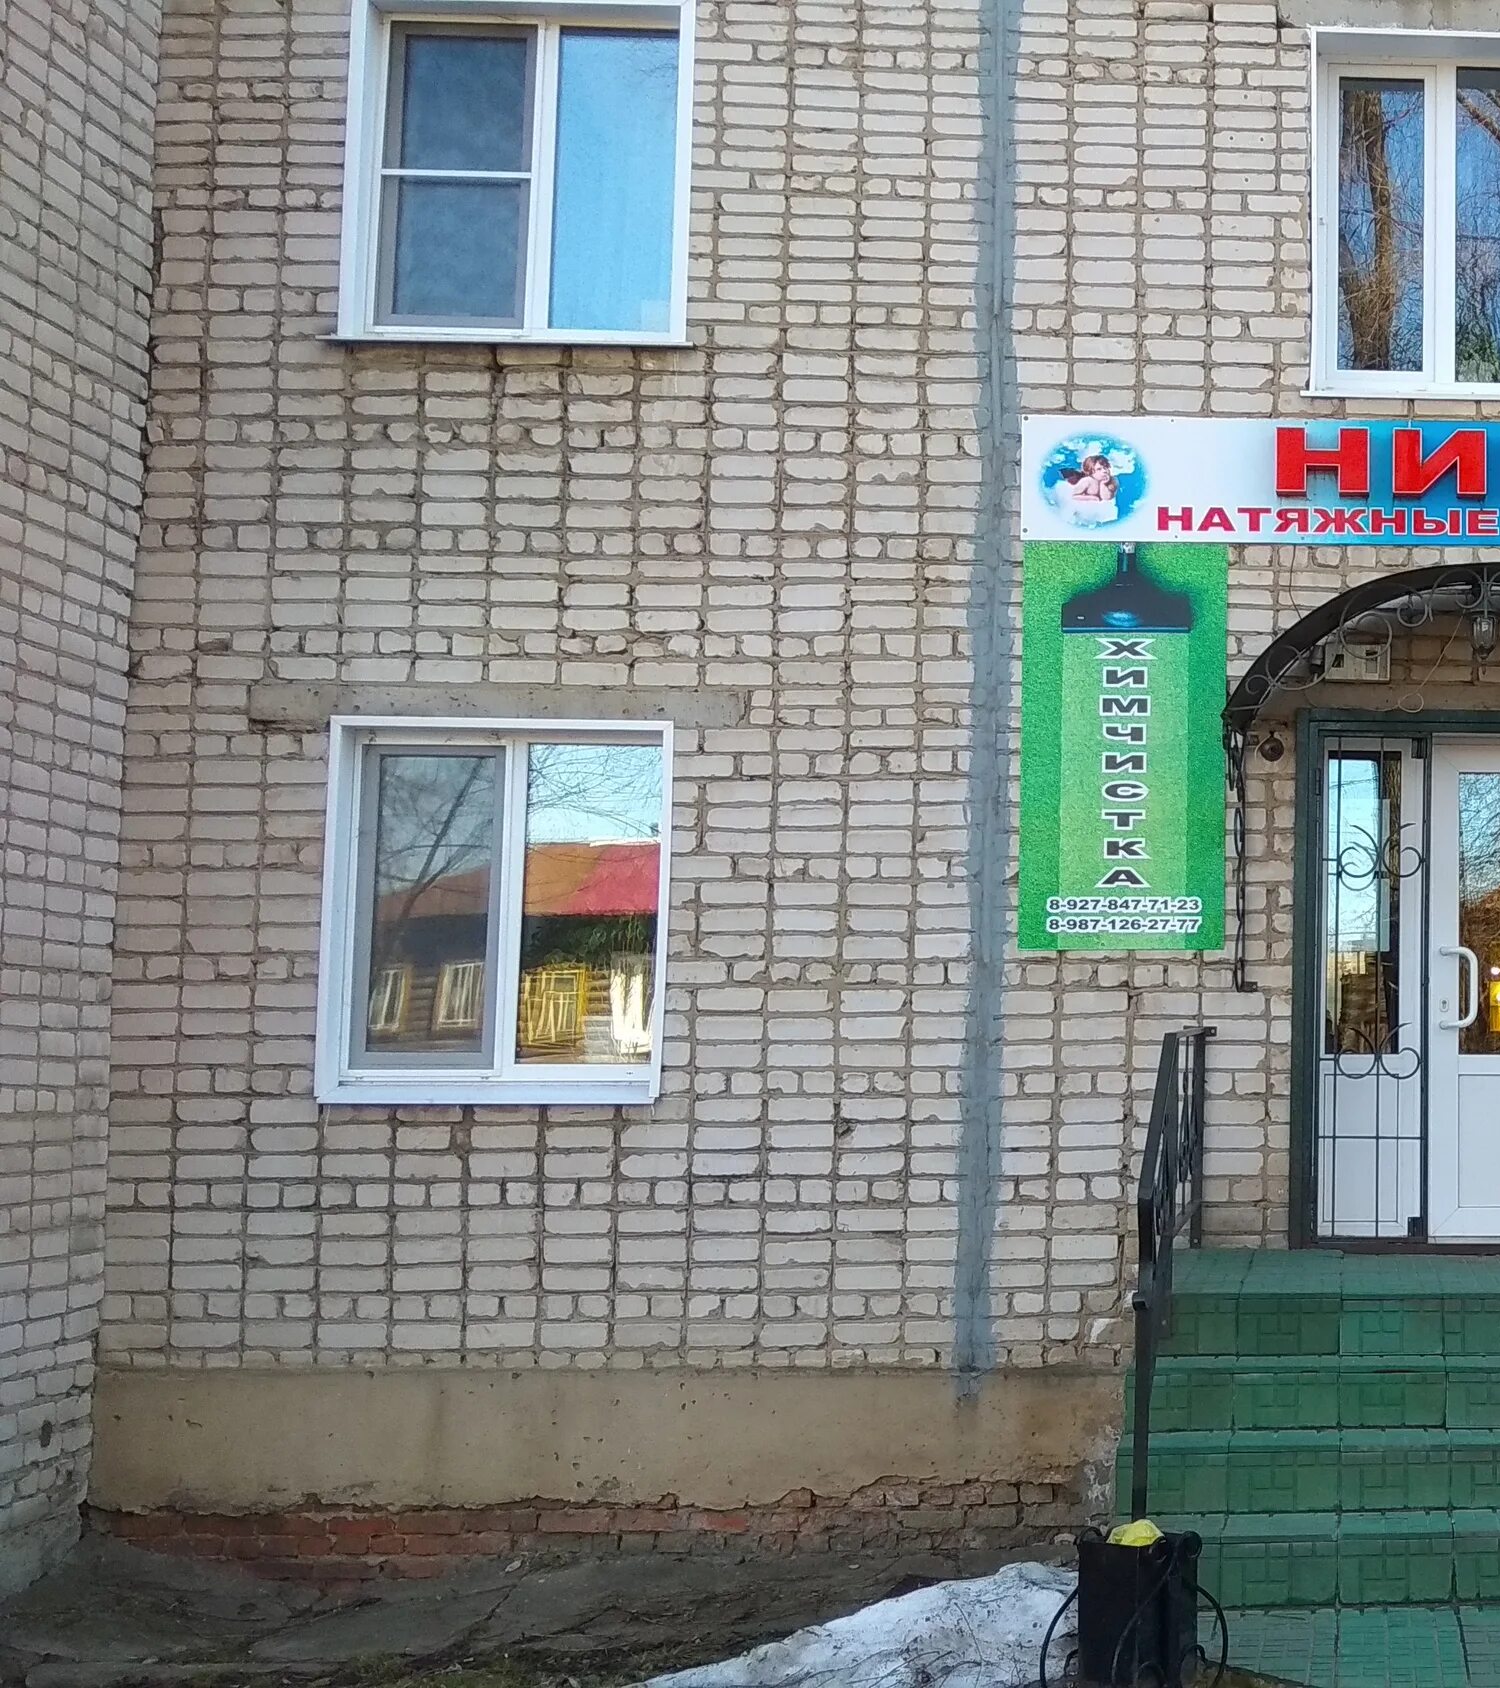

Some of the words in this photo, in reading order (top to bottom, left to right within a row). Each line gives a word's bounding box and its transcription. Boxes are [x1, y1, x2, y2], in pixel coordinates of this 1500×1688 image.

[1156, 506, 1500, 535] НАТЯЖНЫЕ
[1094, 638, 1157, 888] ХИМЧИСТКА
[1047, 897, 1202, 913] 8-927-847-71-23
[1047, 917, 1202, 932] 8-987-126-27-77
